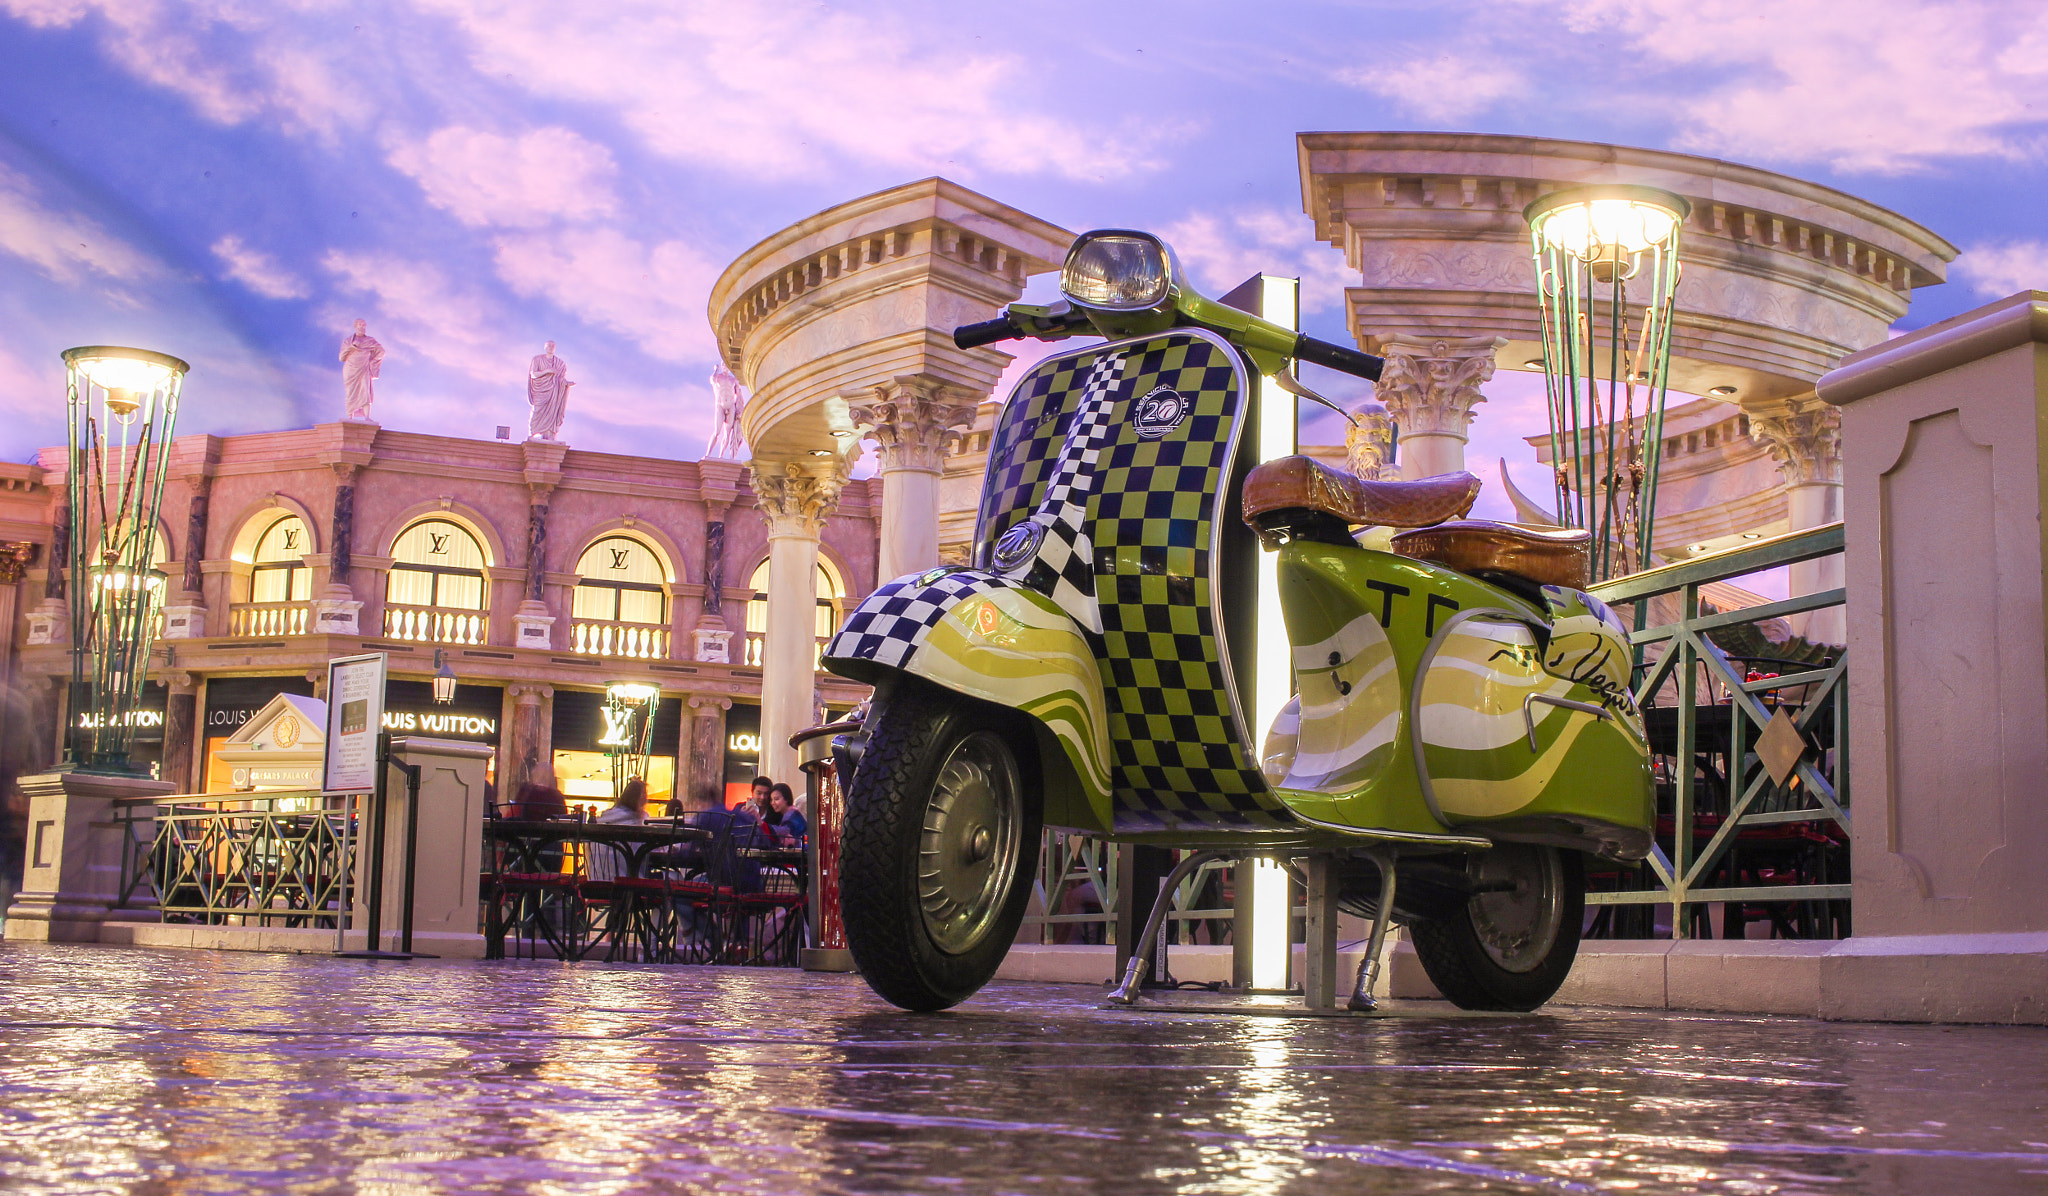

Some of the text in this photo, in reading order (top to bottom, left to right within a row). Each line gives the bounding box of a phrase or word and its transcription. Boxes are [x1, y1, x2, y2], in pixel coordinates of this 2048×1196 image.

[209, 710, 246, 725] LOUIS
[381, 711, 496, 734] OUIS VUITTON
[730, 733, 762, 752] LOU
[250, 771, 309, 781] CAESARS PALACE
